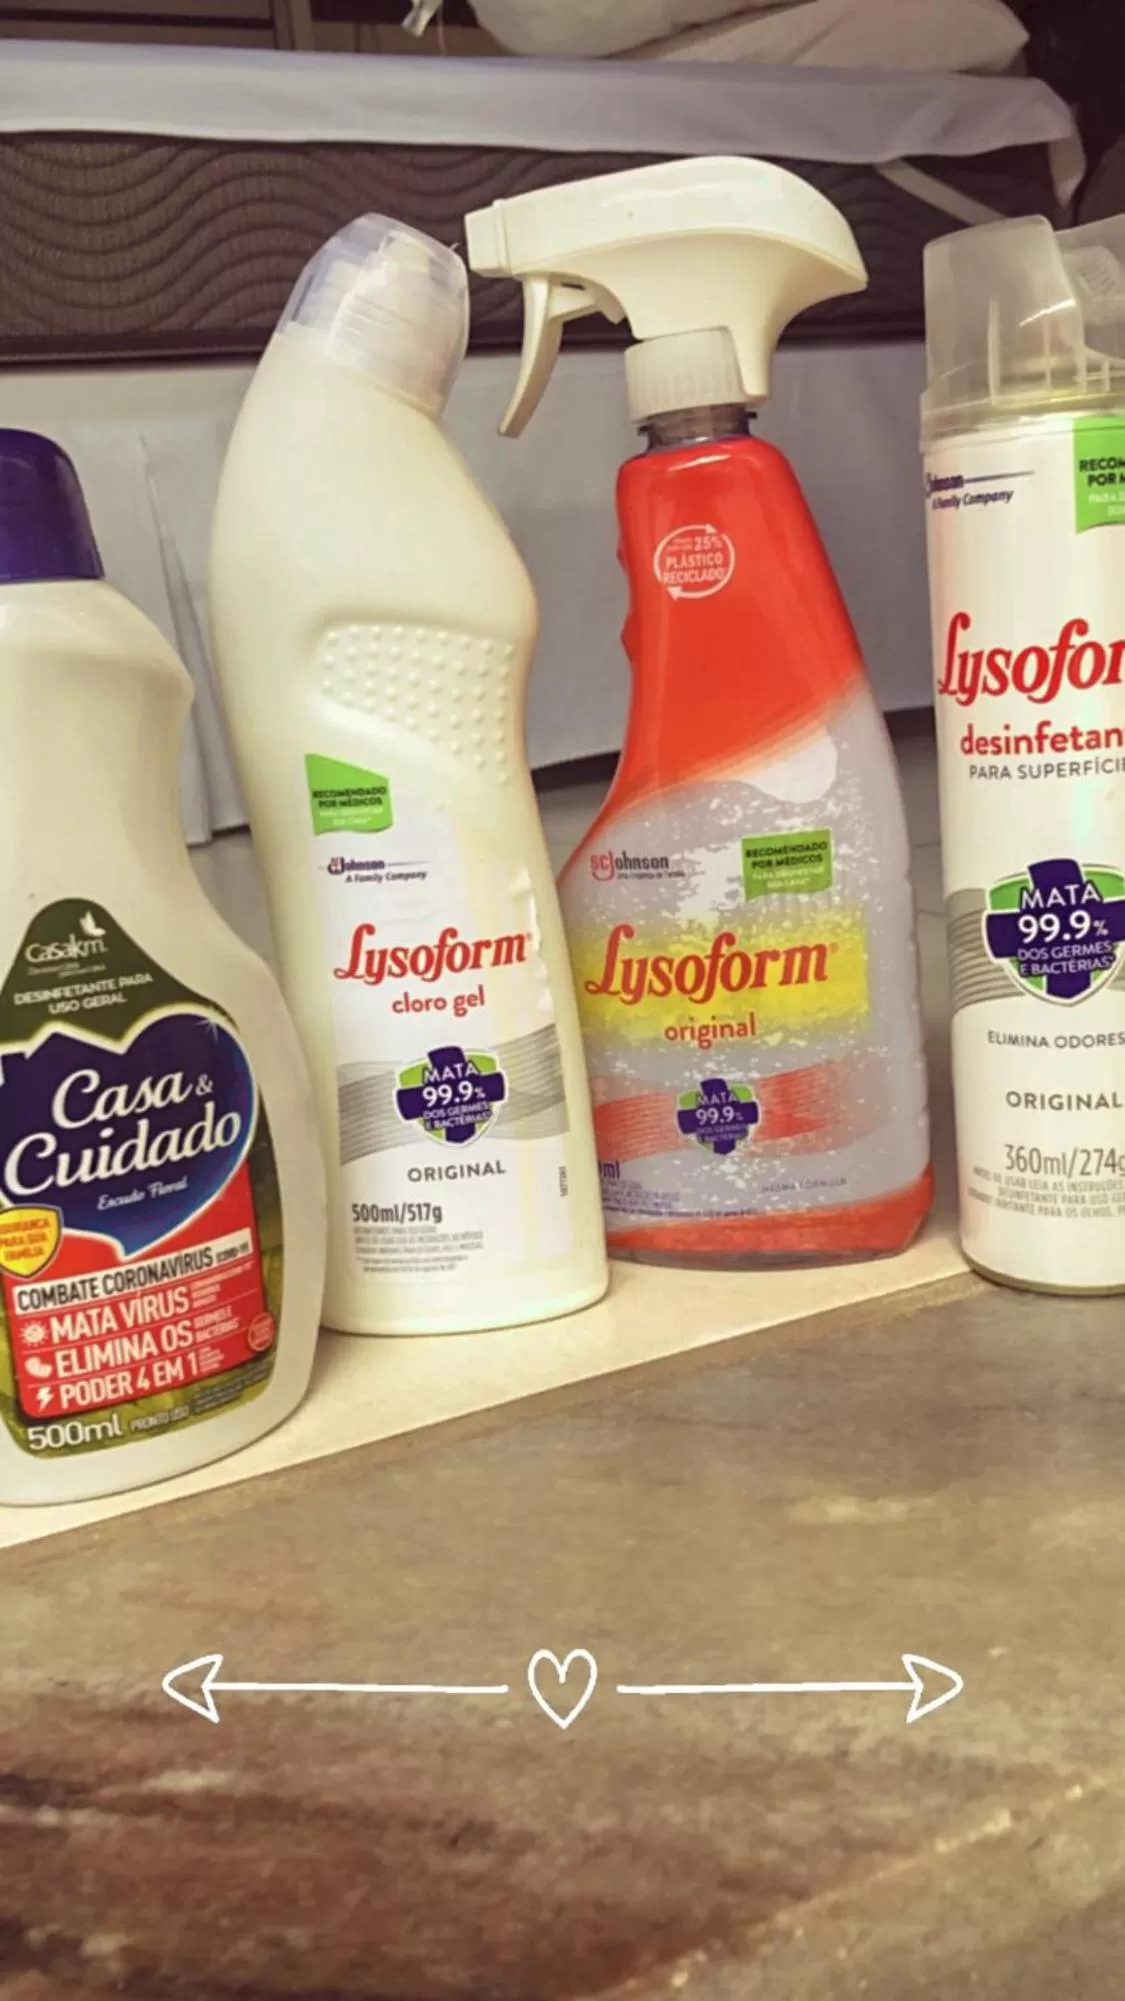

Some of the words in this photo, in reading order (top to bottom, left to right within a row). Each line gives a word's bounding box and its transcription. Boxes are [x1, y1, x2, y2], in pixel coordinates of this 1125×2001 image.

[960, 720, 1125, 755] desinfetan
[969, 763, 1012, 781] PARA
[385, 871, 427, 882] Company
[752, 859, 773, 870] POR
[1020, 882, 1102, 910] MATA
[1018, 910, 1109, 944] 99.9%
[333, 922, 527, 987] Lysoform
[584, 923, 829, 1006] Lysoform
[1018, 947, 1049, 961] DOS
[1051, 940, 1112, 959] GERMES
[1020, 964, 1029, 976] E
[13, 978, 117, 1006] DESINFETANTE
[118, 972, 153, 988] PARA
[48, 999, 81, 1015] USO
[82, 991, 128, 1010] GERAL
[392, 991, 448, 1014] cloro
[453, 983, 485, 1018] gel
[664, 1012, 756, 1050] original
[988, 1029, 1050, 1048] ELIMINA
[1054, 1032, 1125, 1049] ODORES
[423, 1062, 480, 1085] MATA
[52, 1068, 194, 1129] Casa
[195, 1073, 214, 1096] &
[422, 1080, 487, 1108] 99.9%
[1005, 1090, 1123, 1111] ORIGINAL
[423, 1108, 446, 1120] DOS
[4, 1101, 242, 1197] Cuidado
[407, 1159, 506, 1183] ORIGINAL
[149, 1176, 189, 1199] Floral
[351, 1202, 443, 1224] 500ml/517g
[17, 1277, 101, 1312] COMBATE
[51, 1313, 118, 1345] MATA
[120, 1286, 189, 1323] VÍRUS
[55, 1338, 159, 1379] ELIMINA
[161, 1321, 193, 1351] OS
[59, 1373, 133, 1410] PODER
[136, 1367, 151, 1391] 4
[153, 1358, 184, 1387] EM
[188, 1352, 198, 1376] 1
[28, 1413, 123, 1450] 500ml
